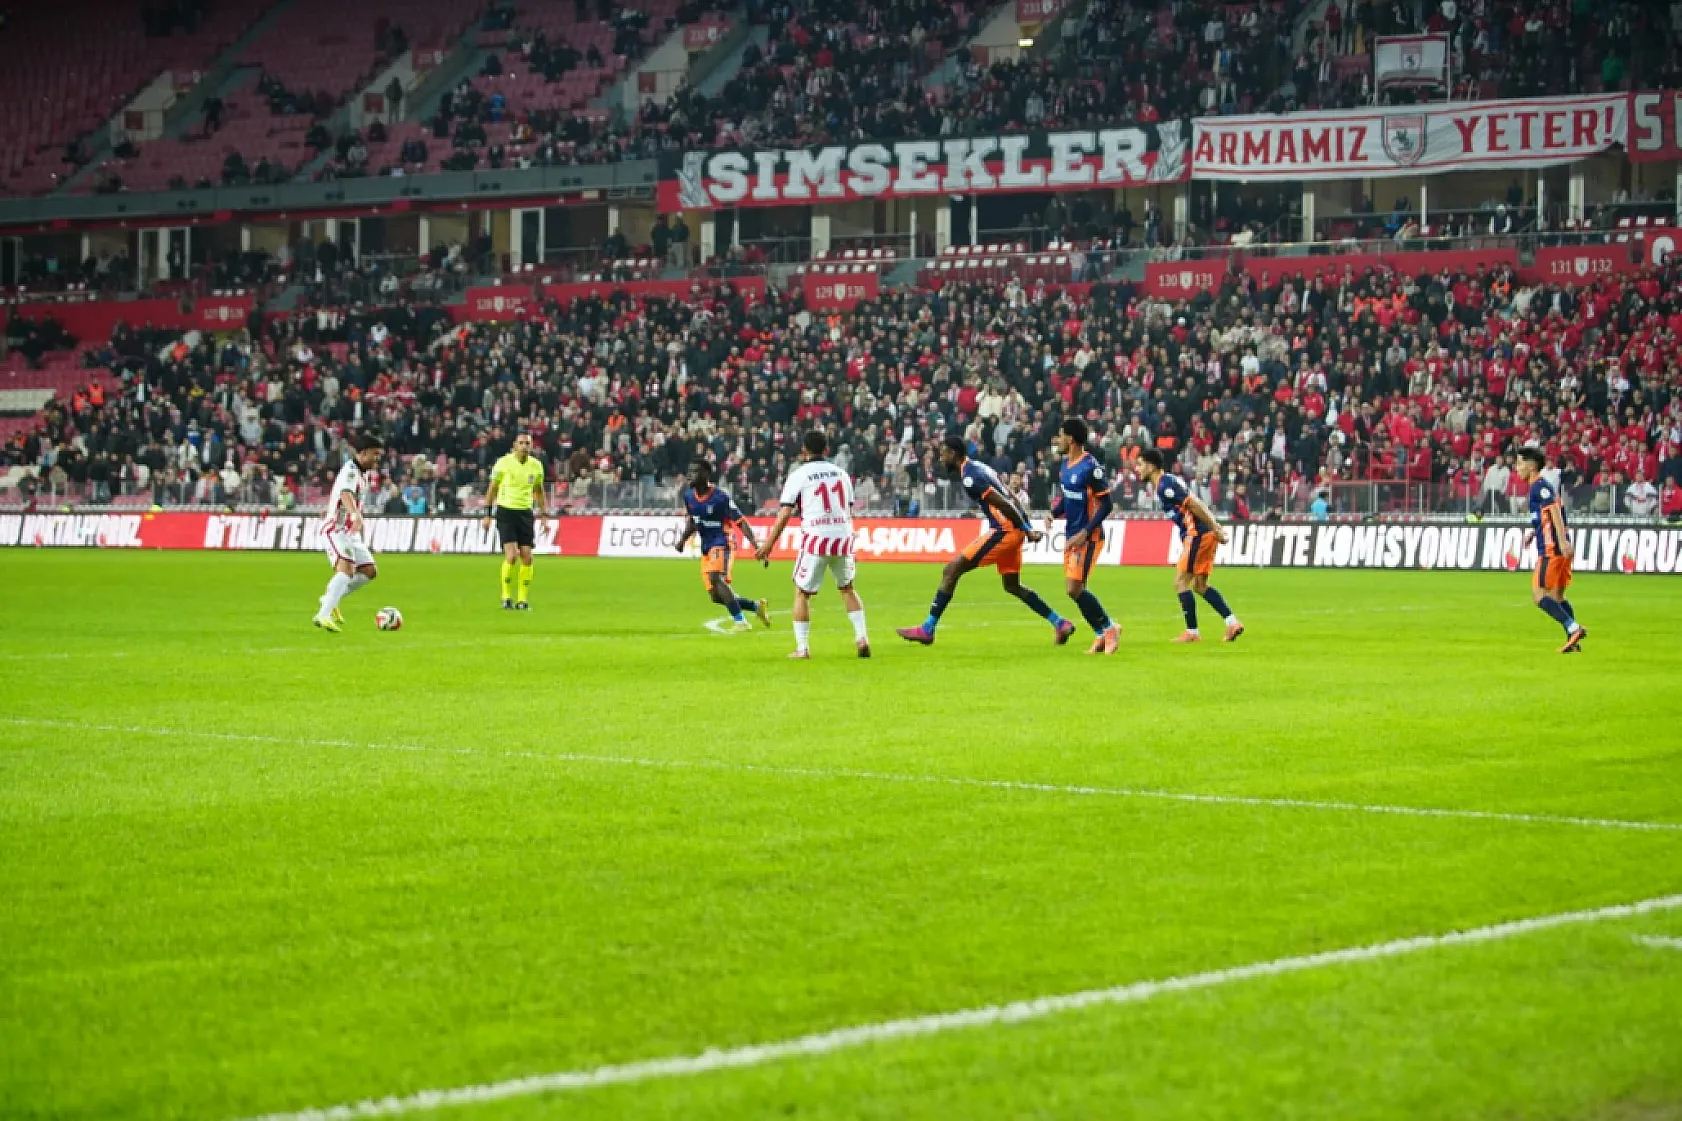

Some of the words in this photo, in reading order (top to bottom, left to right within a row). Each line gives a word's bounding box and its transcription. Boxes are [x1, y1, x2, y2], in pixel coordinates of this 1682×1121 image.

[1194, 126, 1369, 165] ARMAMIZ
[1454, 105, 1614, 153] YETER!
[1634, 93, 1682, 151] S
[707, 127, 1150, 202] SIMSEKLER
[1159, 273, 1177, 287] 130
[1551, 260, 1571, 274] 131
[1592, 258, 1612, 273] 132
[814, 481, 846, 513] 11
